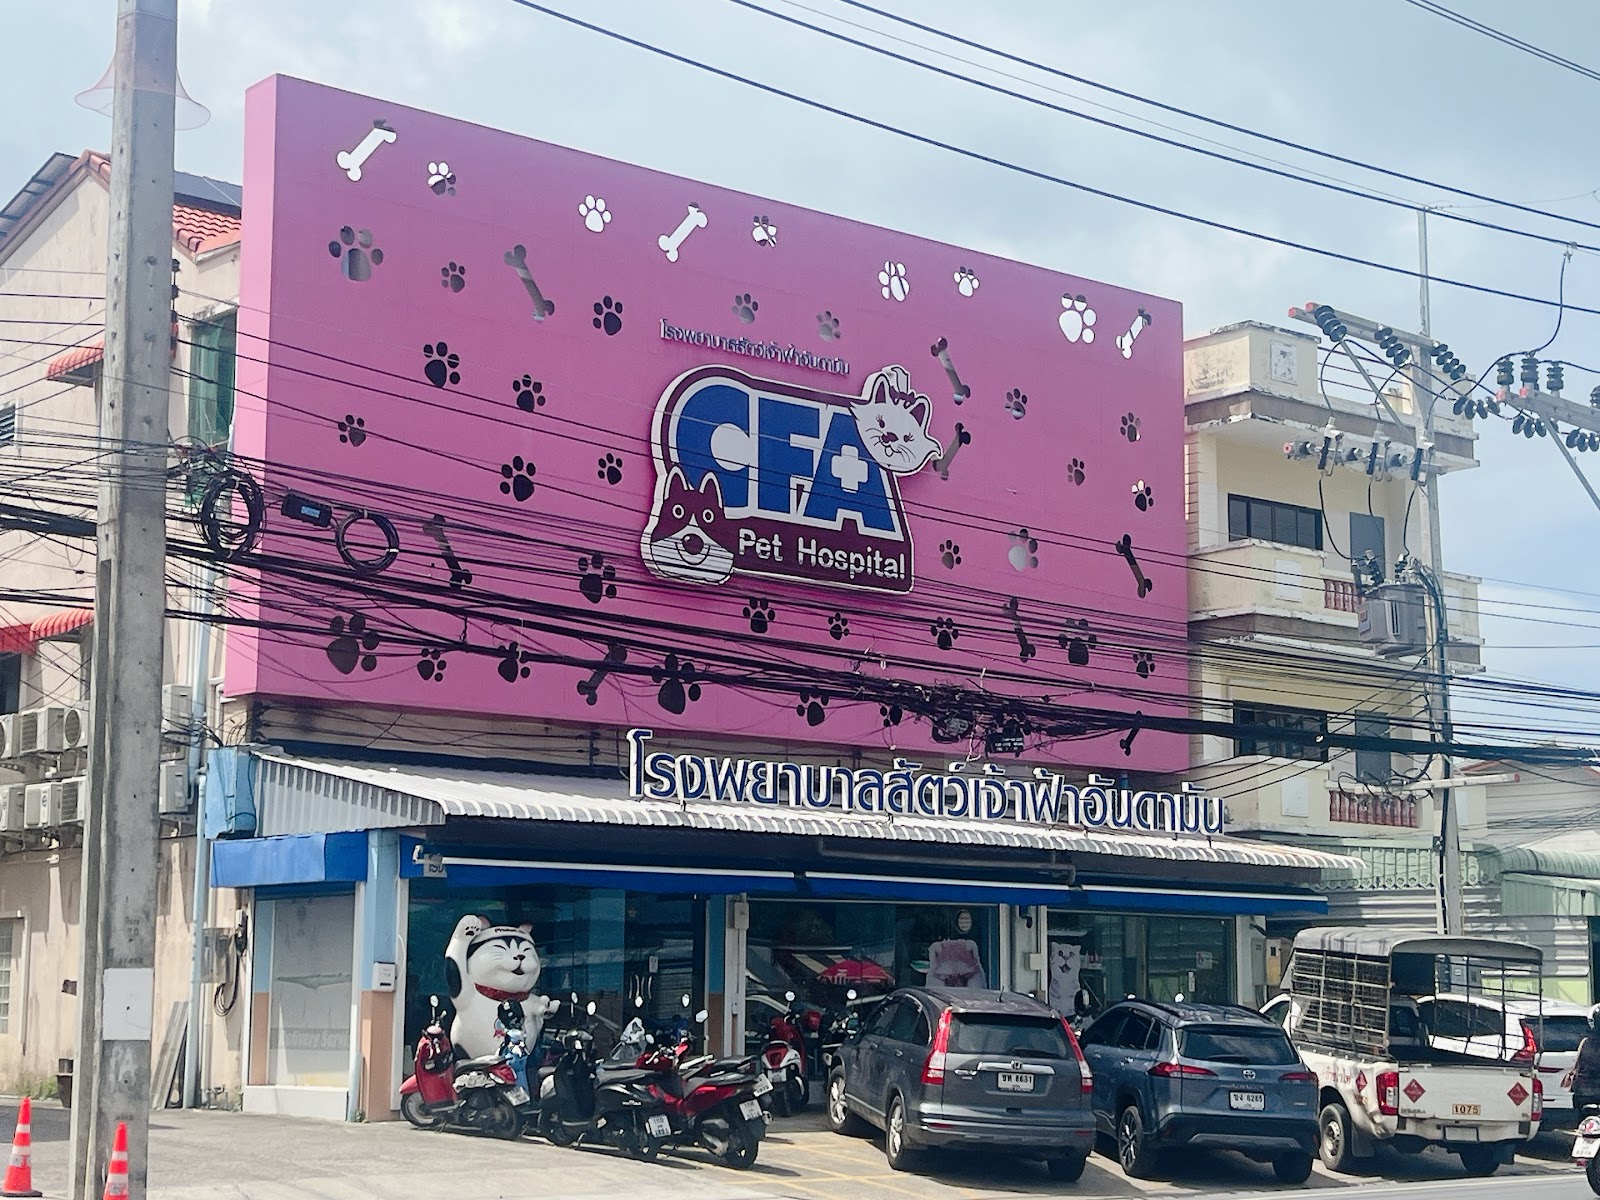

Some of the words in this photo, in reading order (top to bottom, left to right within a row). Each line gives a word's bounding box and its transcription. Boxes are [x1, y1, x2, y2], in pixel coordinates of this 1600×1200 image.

[674, 383, 898, 533] CFA
[738, 528, 784, 562] Pet
[798, 536, 906, 580] Hospital
[625, 728, 1225, 835] โรงพยาบาลสัตว์เจ้าฟ้าอันดามัน
[1454, 1105, 1479, 1114] 1075
